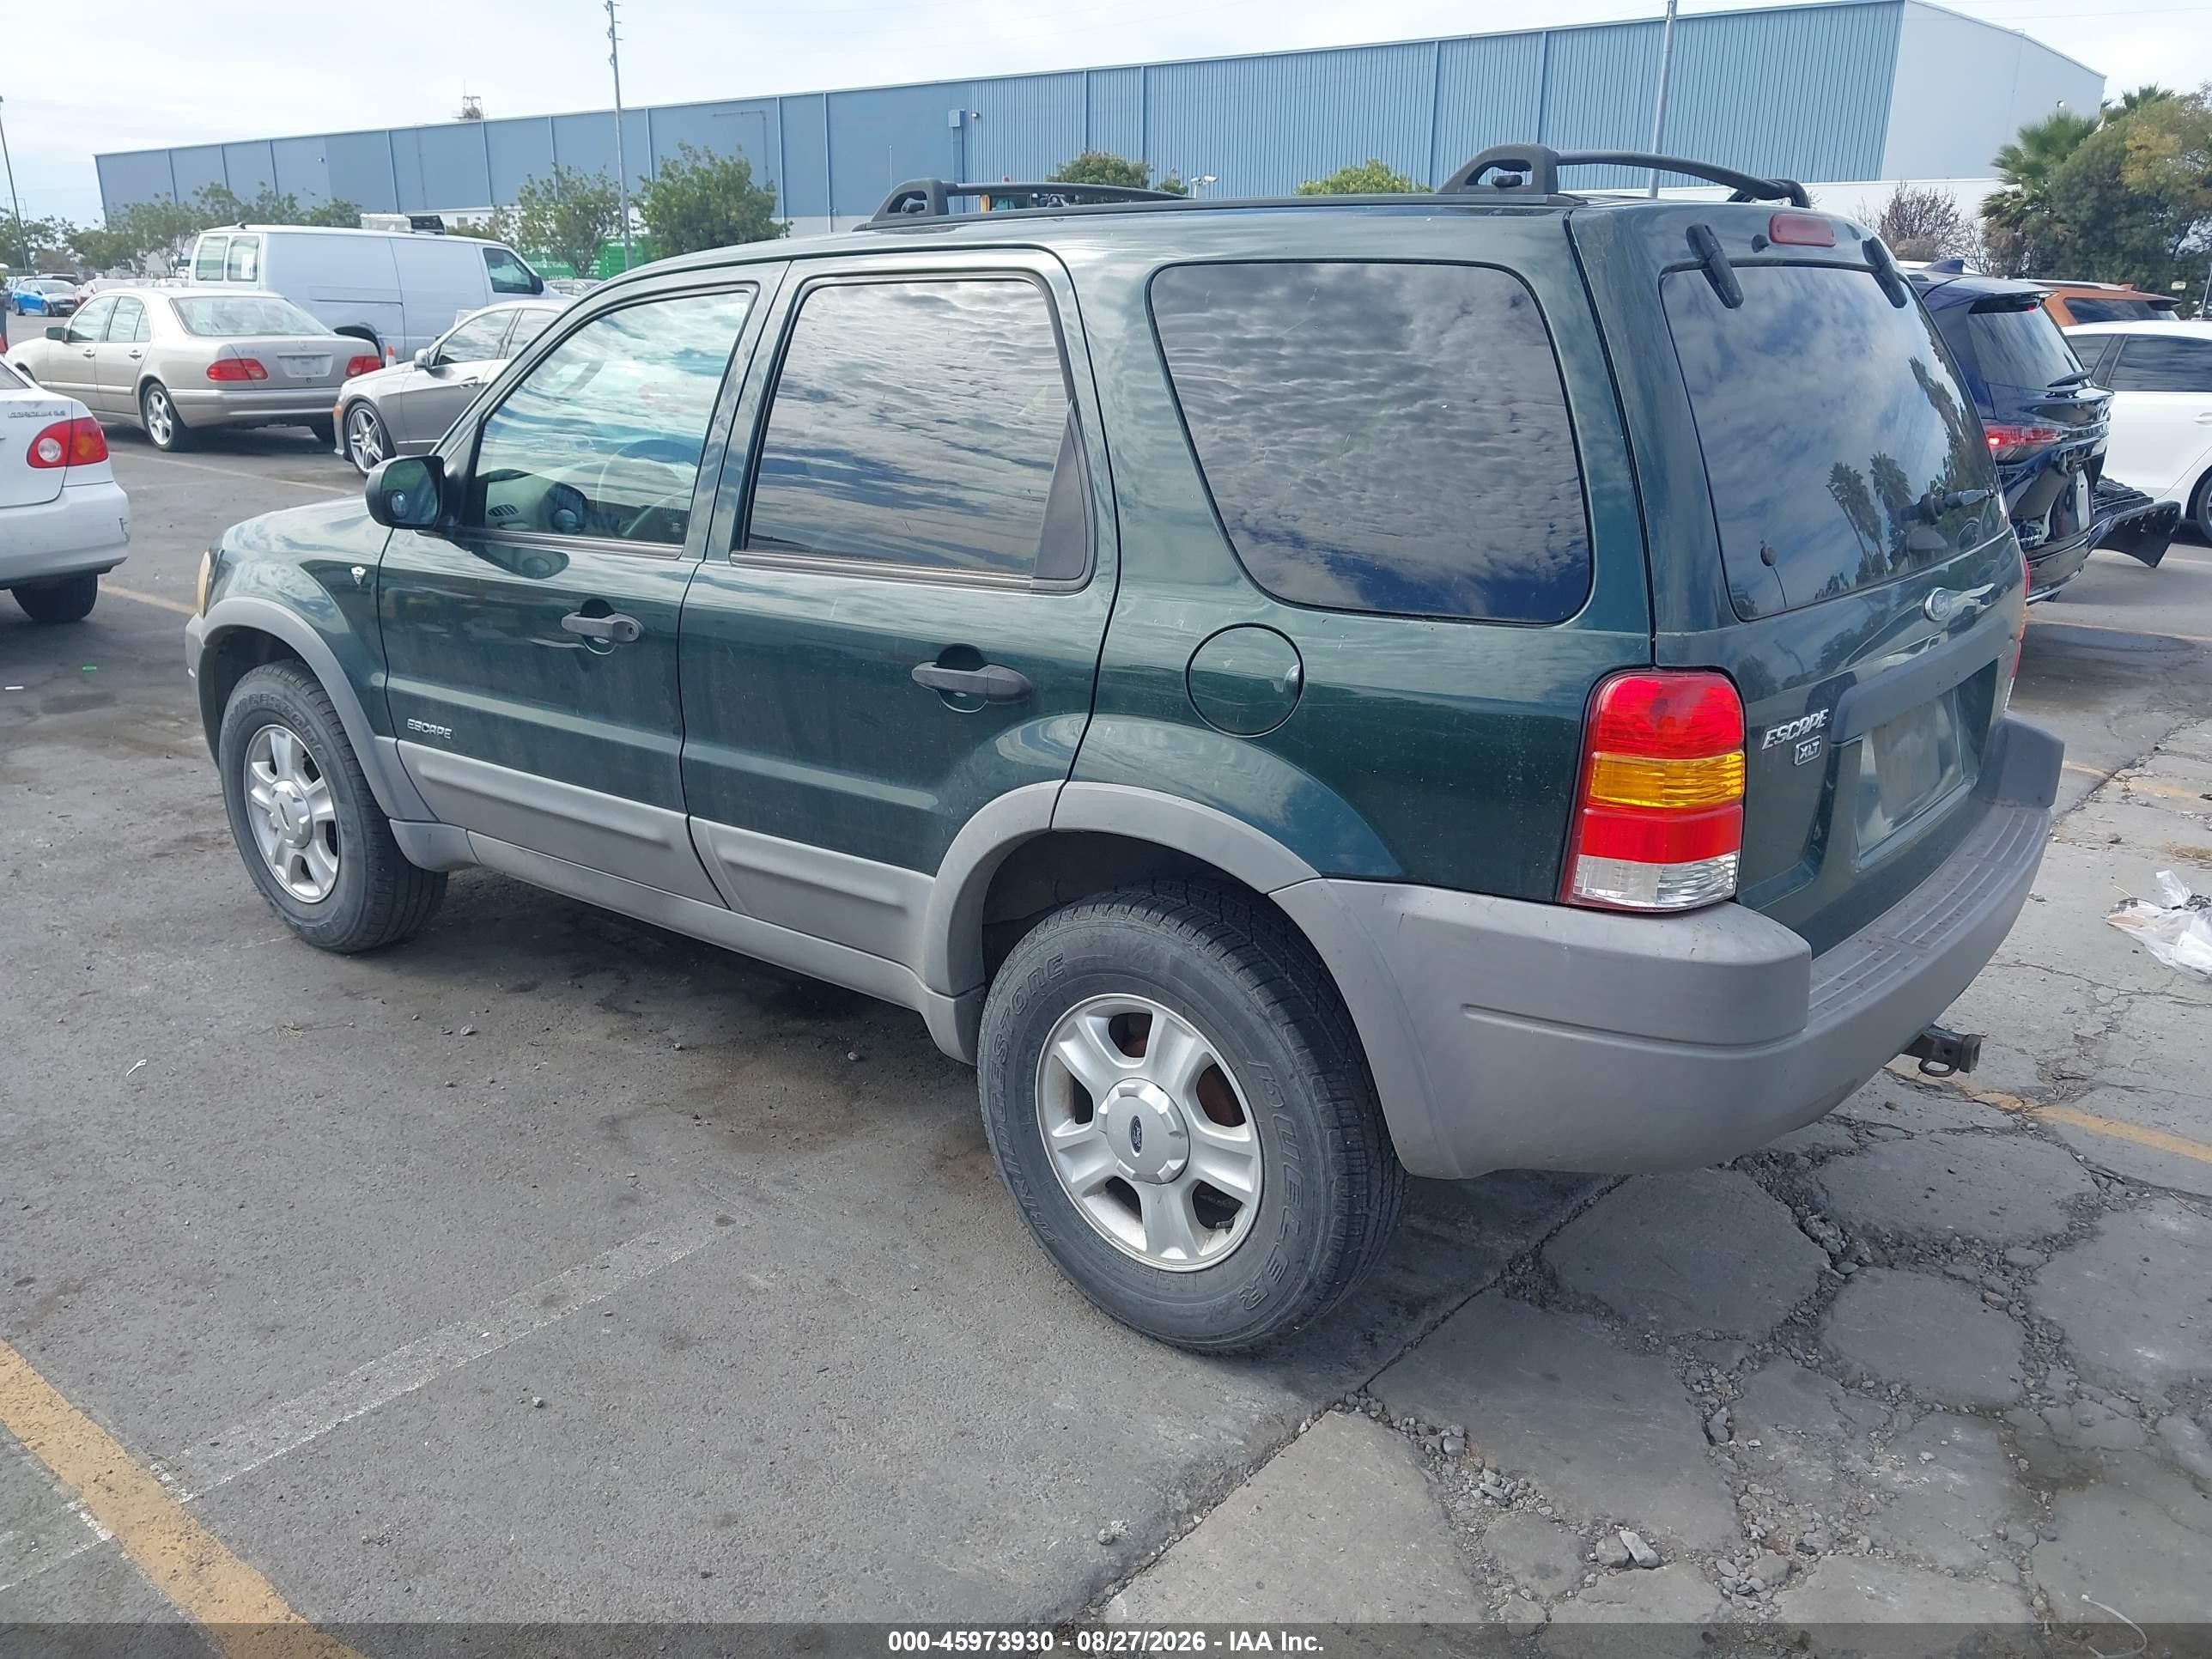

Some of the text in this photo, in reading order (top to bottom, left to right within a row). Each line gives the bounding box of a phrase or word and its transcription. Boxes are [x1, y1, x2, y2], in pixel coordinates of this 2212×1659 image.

[406, 718, 453, 739] ESCAPE
[1761, 708, 1829, 750] ESCAPE
[1798, 740, 1820, 760] XLT
[988, 952, 1066, 1244] BRIDGESTONE
[1240, 1060, 1305, 1311] DUELER
